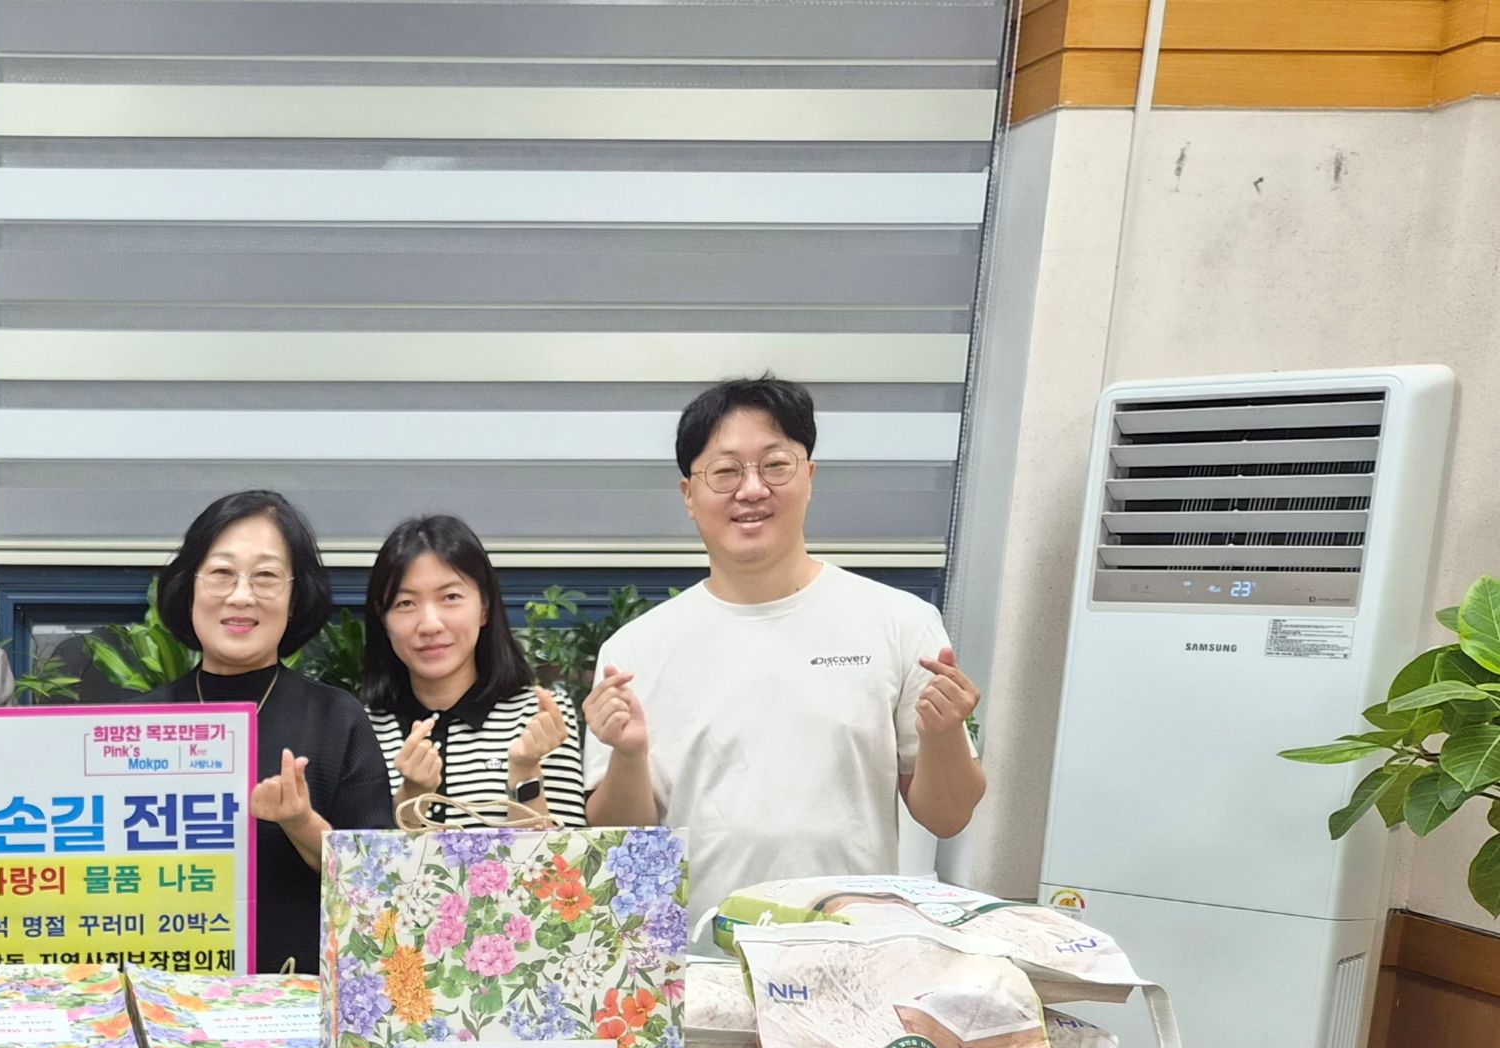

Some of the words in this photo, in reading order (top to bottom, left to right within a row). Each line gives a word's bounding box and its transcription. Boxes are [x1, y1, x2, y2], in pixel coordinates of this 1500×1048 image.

[1231, 581, 1251, 597] 23
[1185, 642, 1238, 652] SAMSUNG
[811, 655, 871, 665] Discovery
[93, 725, 141, 742] 희망찬
[146, 724, 226, 741] 목포만들기
[128, 758, 169, 771] Mokpo
[123, 793, 240, 851] 전달
[83, 865, 142, 893] 물품
[158, 864, 216, 892] 나눔
[22, 914, 66, 937] 명절
[79, 913, 145, 936] 꾸러미
[158, 913, 231, 935] 20박스
[769, 982, 808, 1000] NH
